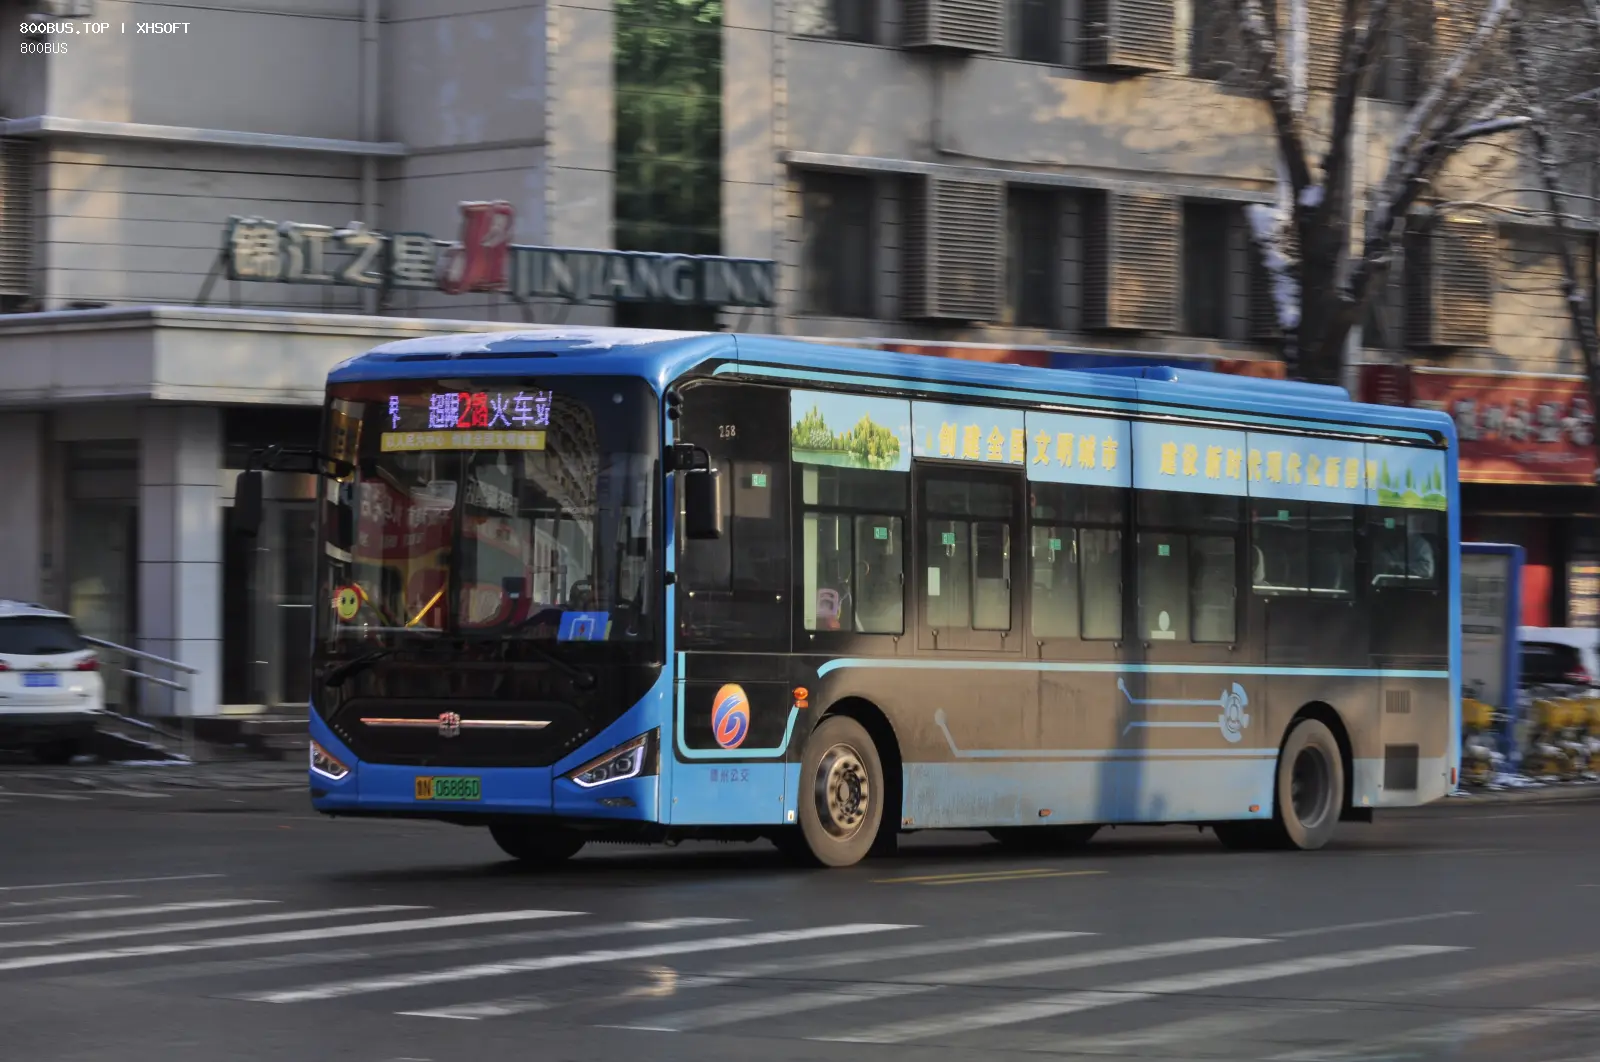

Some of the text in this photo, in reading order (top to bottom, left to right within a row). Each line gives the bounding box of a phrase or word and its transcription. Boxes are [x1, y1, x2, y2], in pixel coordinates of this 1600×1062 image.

[231, 217, 436, 289] 锦江之星
[718, 425, 736, 438] 258
[938, 422, 1119, 471] 创建全国文明城市
